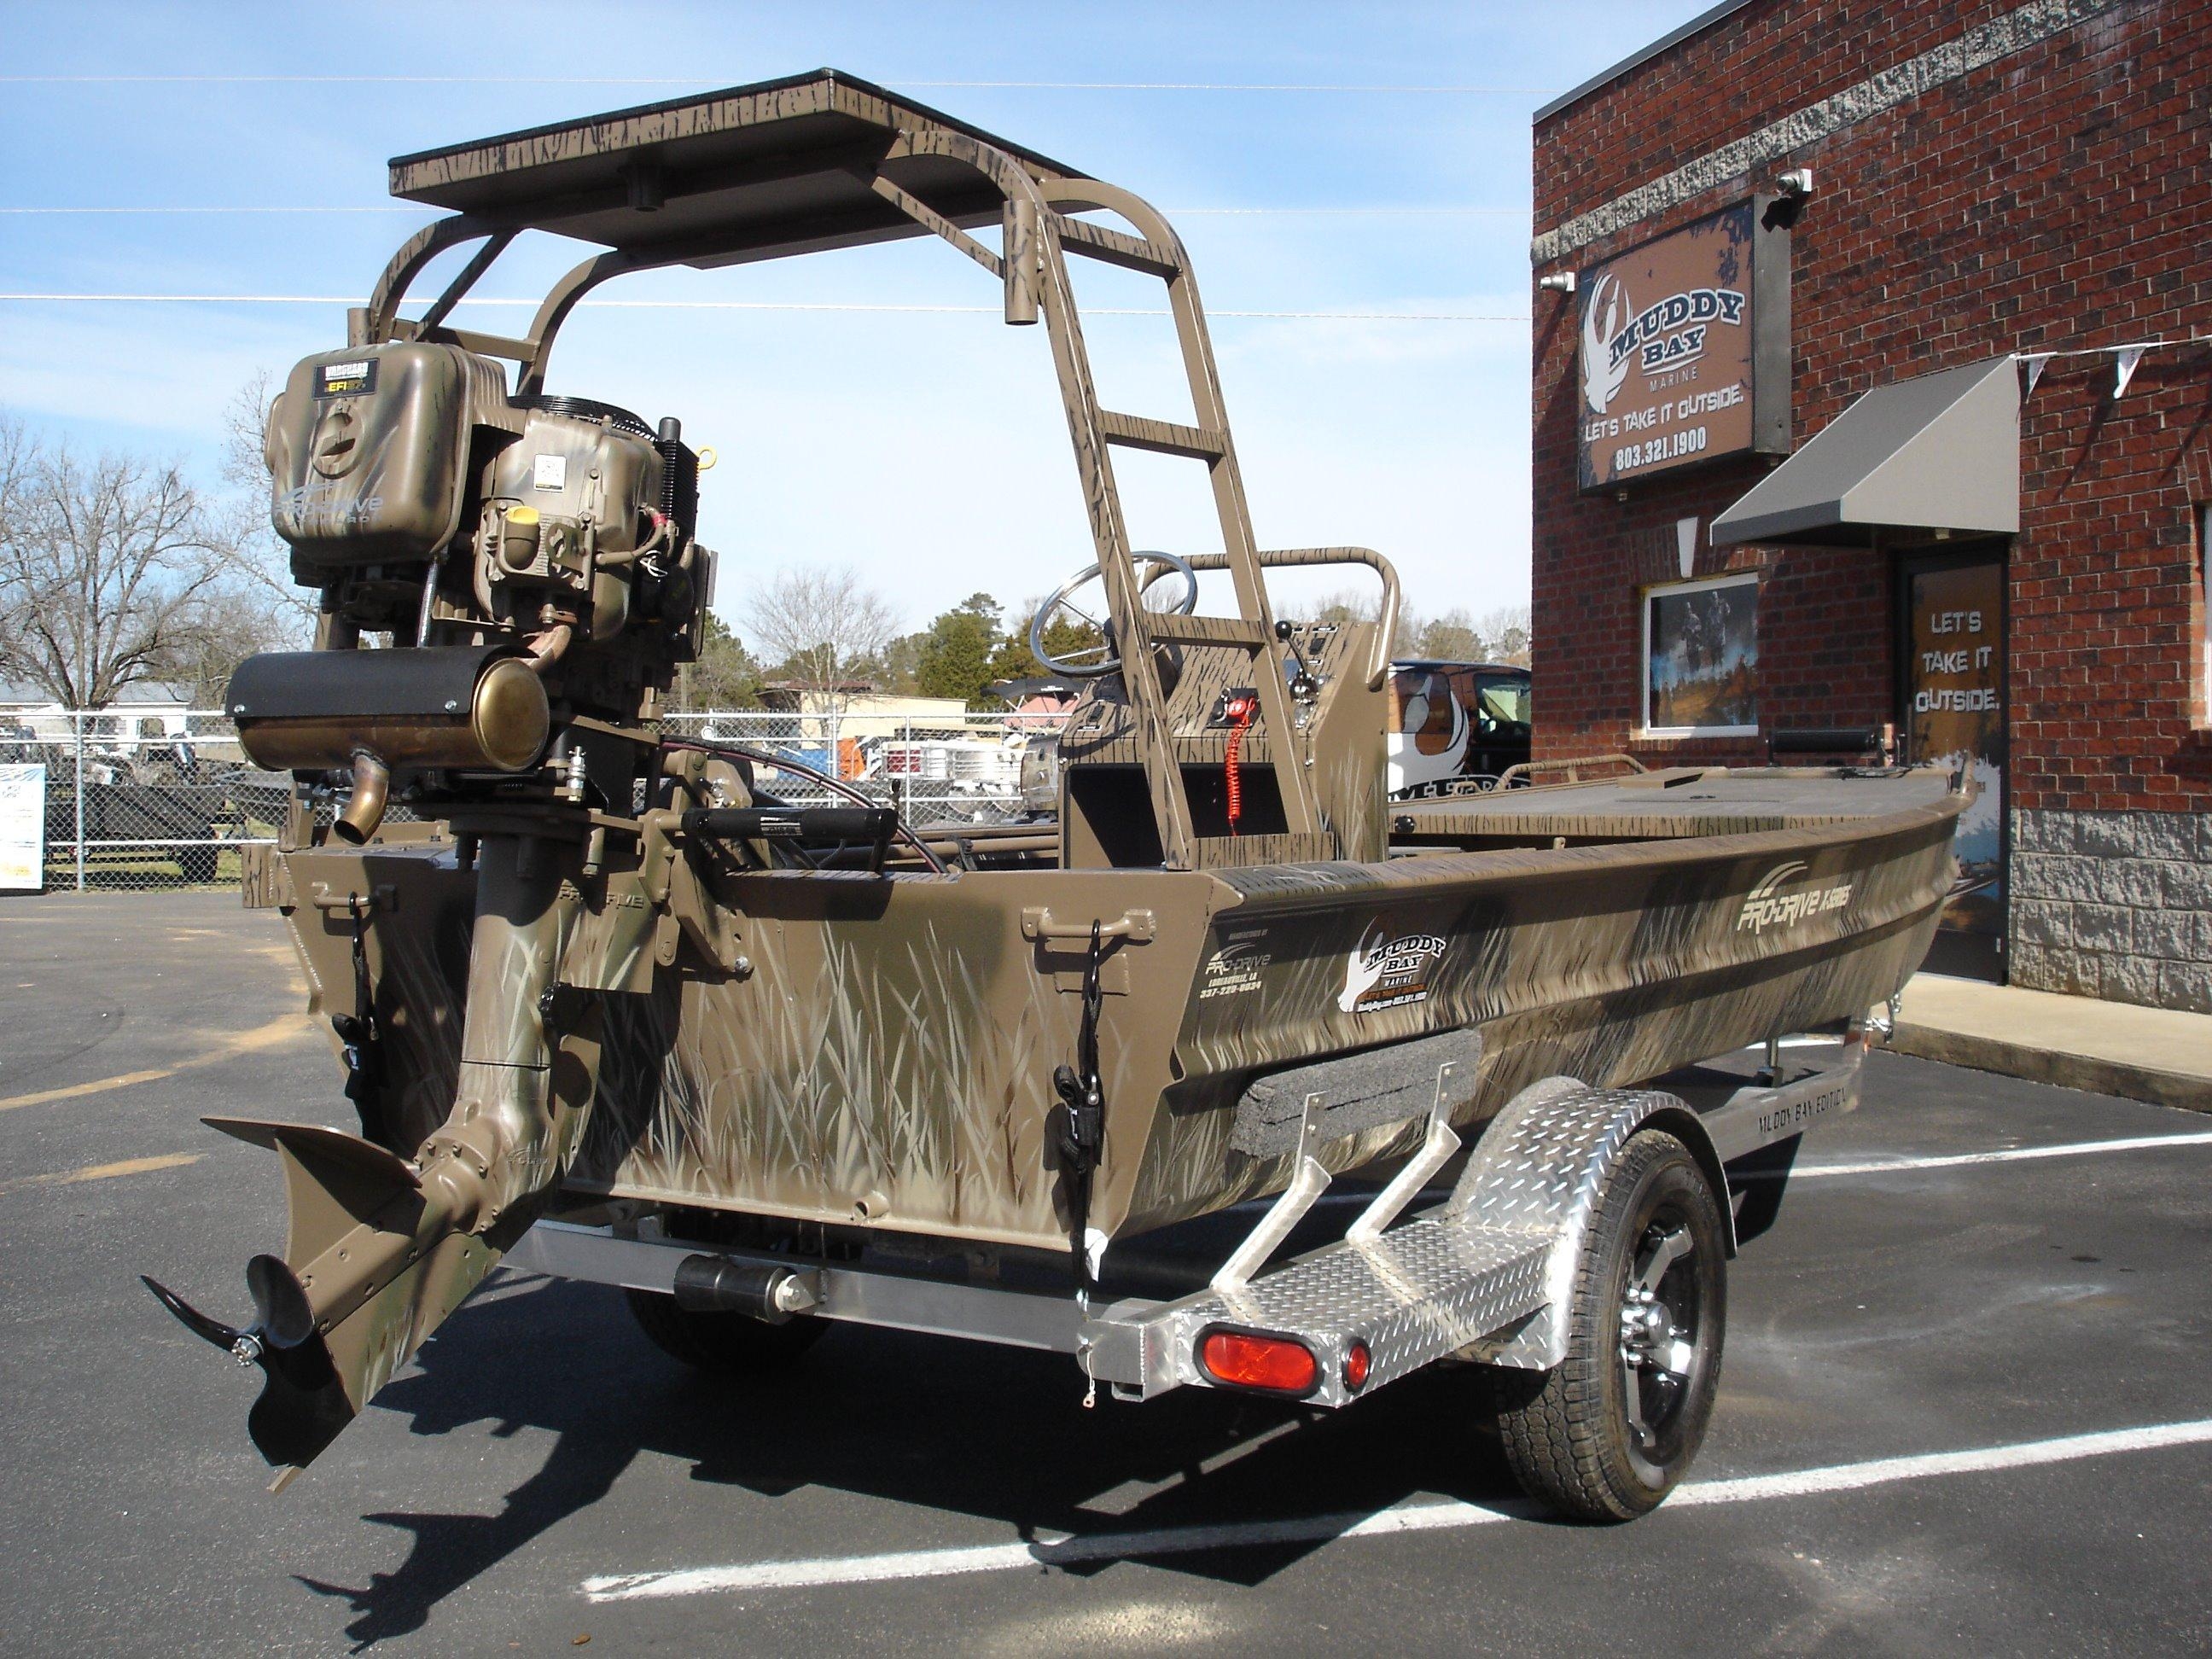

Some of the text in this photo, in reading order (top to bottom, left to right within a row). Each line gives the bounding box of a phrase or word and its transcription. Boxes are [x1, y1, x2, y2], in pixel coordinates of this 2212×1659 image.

[1609, 288, 1745, 374] MUDDY
[1642, 324, 1706, 370] BAY
[329, 381, 347, 393] EFI
[1649, 366, 1698, 393] MARINE
[1585, 383, 1743, 442] LET'S TAKE IT OUTSIDE.
[1615, 426, 1706, 471] 803.321.1900
[1930, 610, 1982, 634] LET'S
[1922, 646, 1993, 673] TAKE IT
[1915, 687, 2001, 713] OUTSIDE.
[1364, 934, 1447, 973] MUDDY
[1383, 953, 1424, 973] BAY
[1796, 1101, 1812, 1121] BAY
